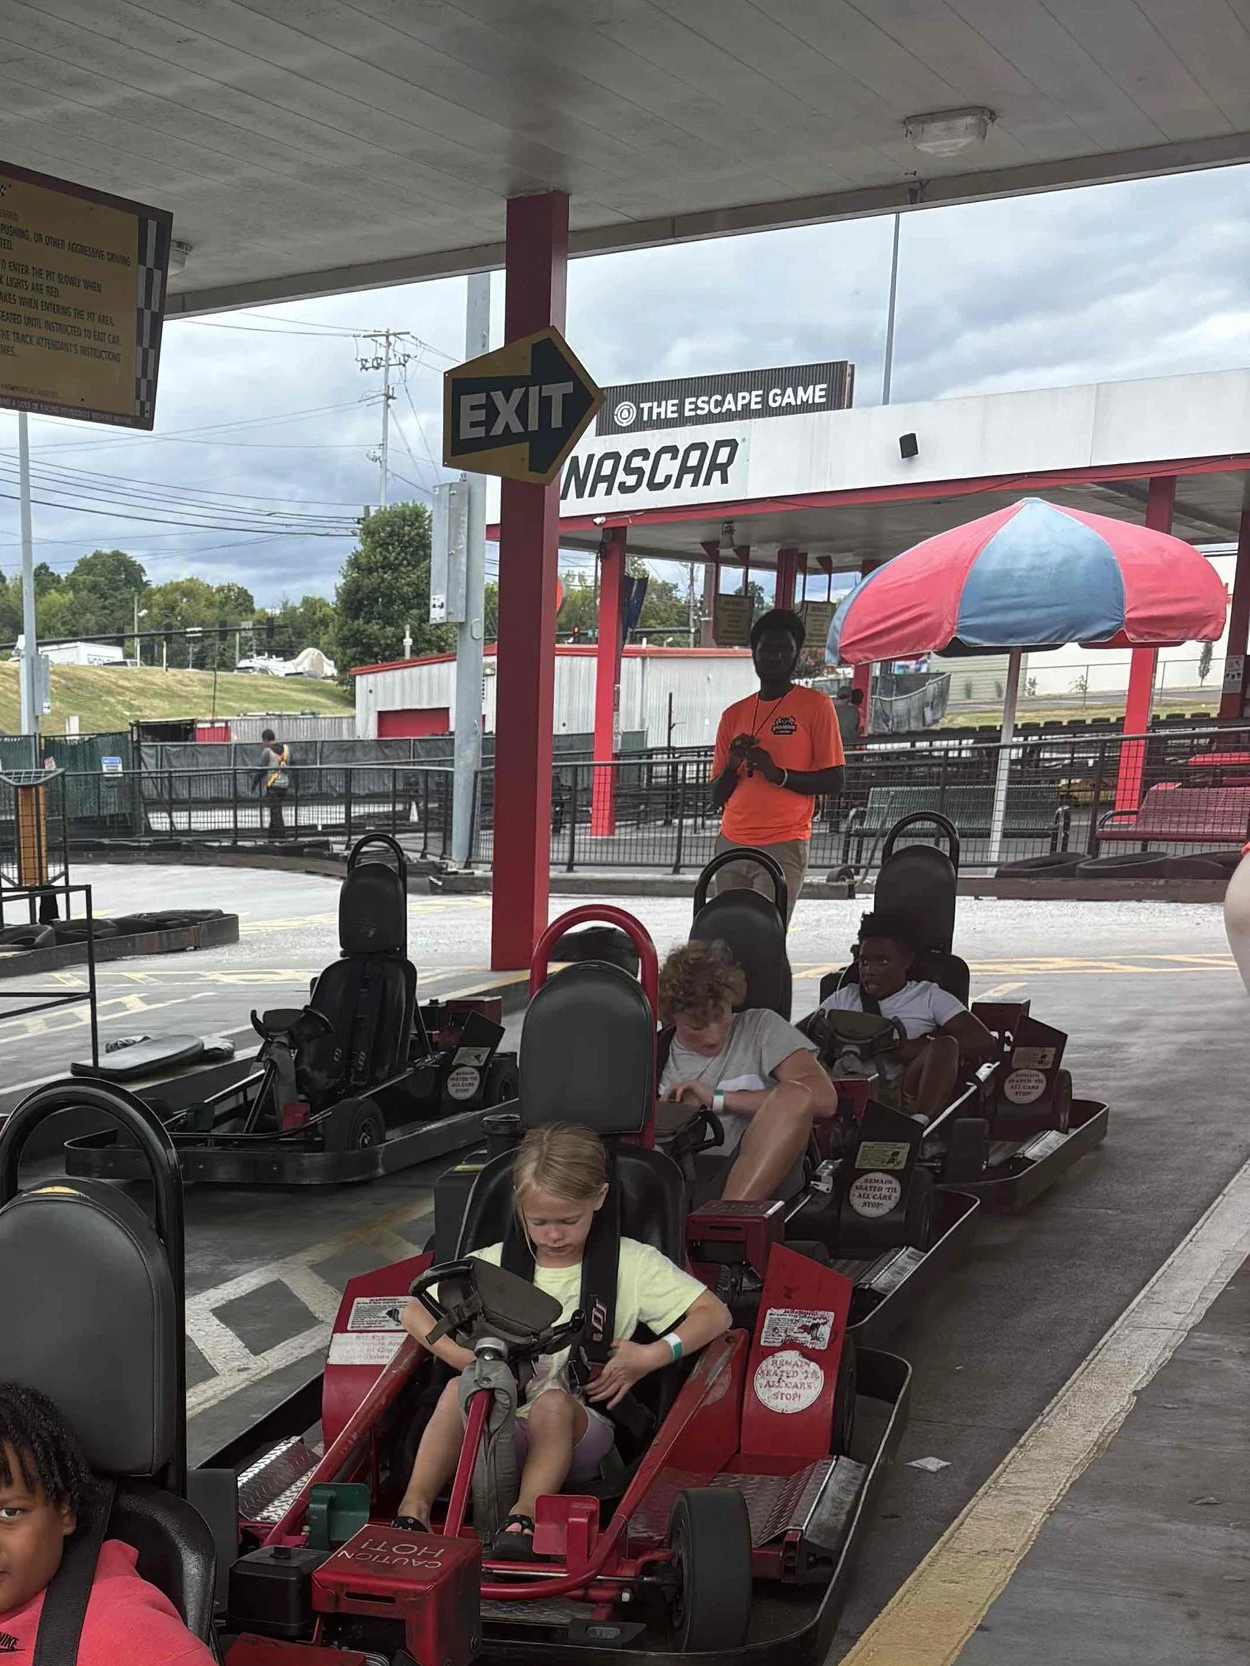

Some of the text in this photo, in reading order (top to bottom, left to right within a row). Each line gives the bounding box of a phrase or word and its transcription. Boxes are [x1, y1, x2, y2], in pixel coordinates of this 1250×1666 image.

[8, 260, 29, 275] ENTER
[31, 266, 43, 279] THE
[6, 275, 28, 290] LIGHTS
[18, 295, 38, 309] WHEN
[73, 308, 84, 319] THE
[459, 381, 574, 440] EXIT
[640, 384, 828, 421] THE ESCAPE GAME
[561, 438, 739, 500] NASCAR
[360, 1539, 445, 1558] HOT!
[337, 1550, 442, 1569] CAUTION
